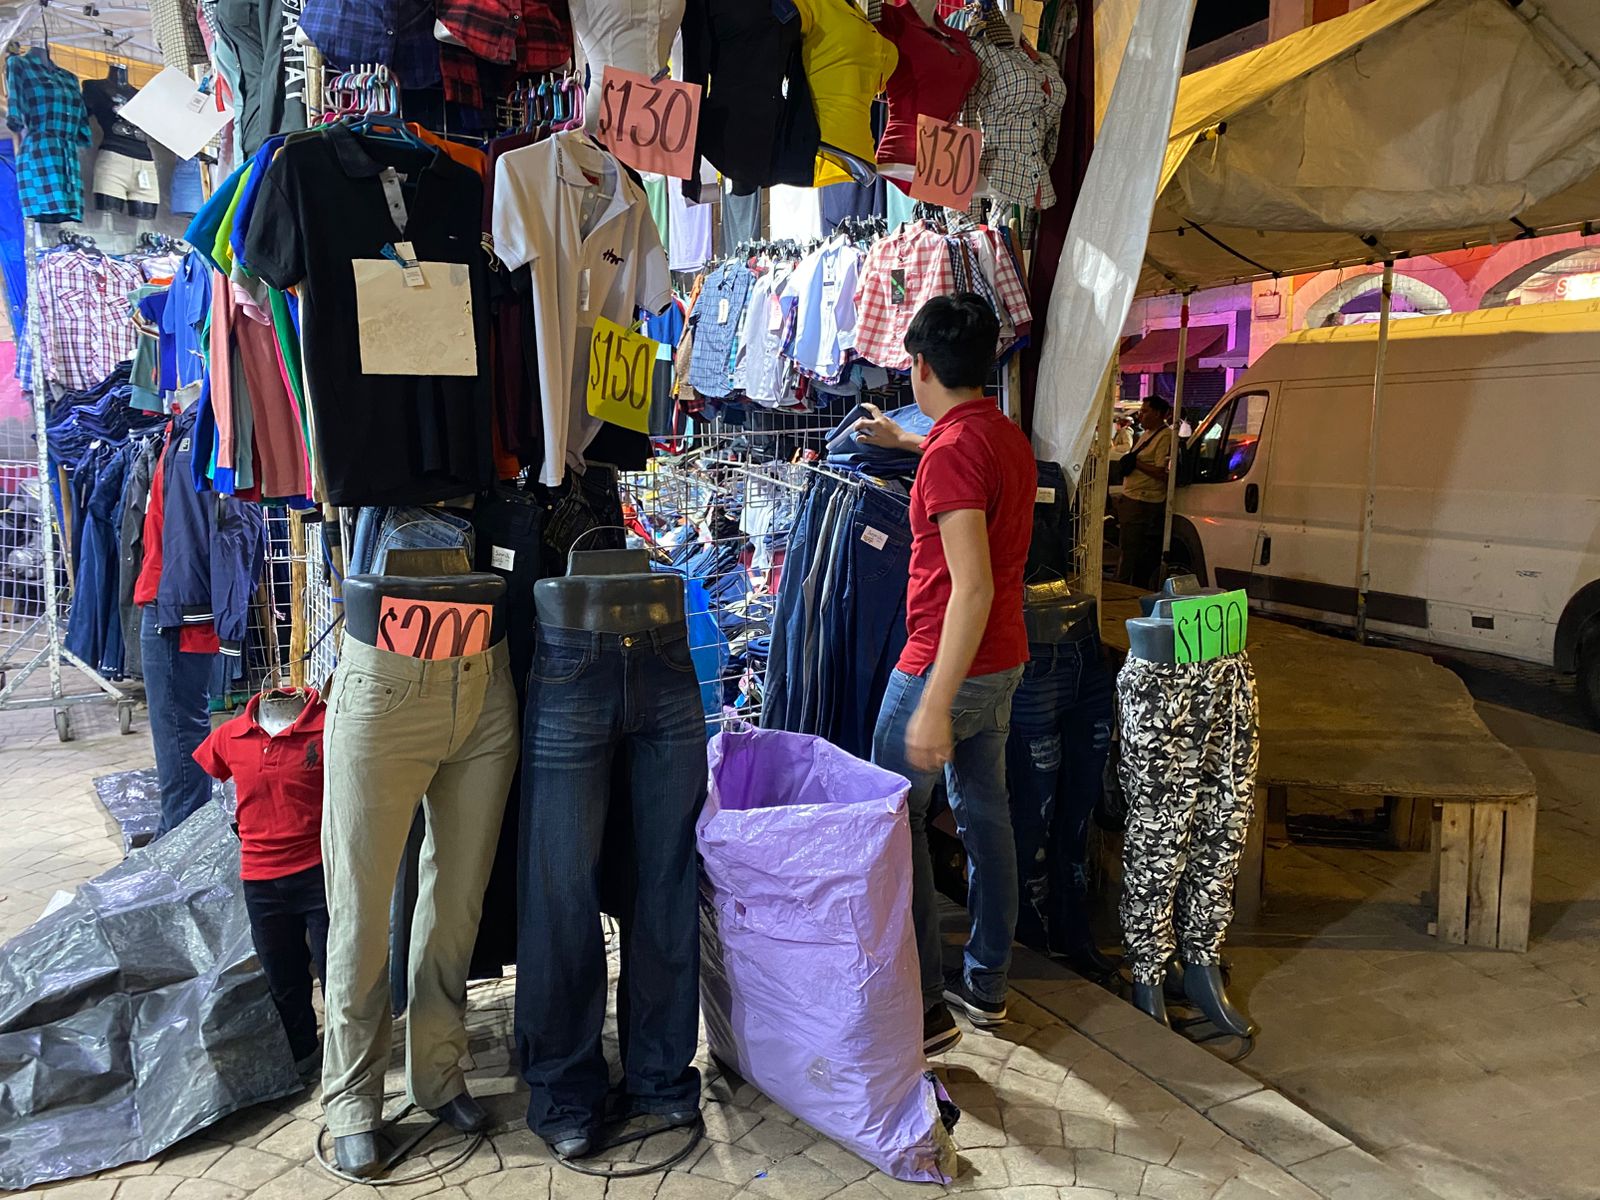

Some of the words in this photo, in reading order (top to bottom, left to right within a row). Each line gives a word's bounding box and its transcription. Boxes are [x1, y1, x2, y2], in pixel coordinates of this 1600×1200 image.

[599, 79, 693, 153] $130
[917, 125, 975, 196] $130
[590, 330, 650, 410] $150
[1177, 601, 1243, 663] $190
